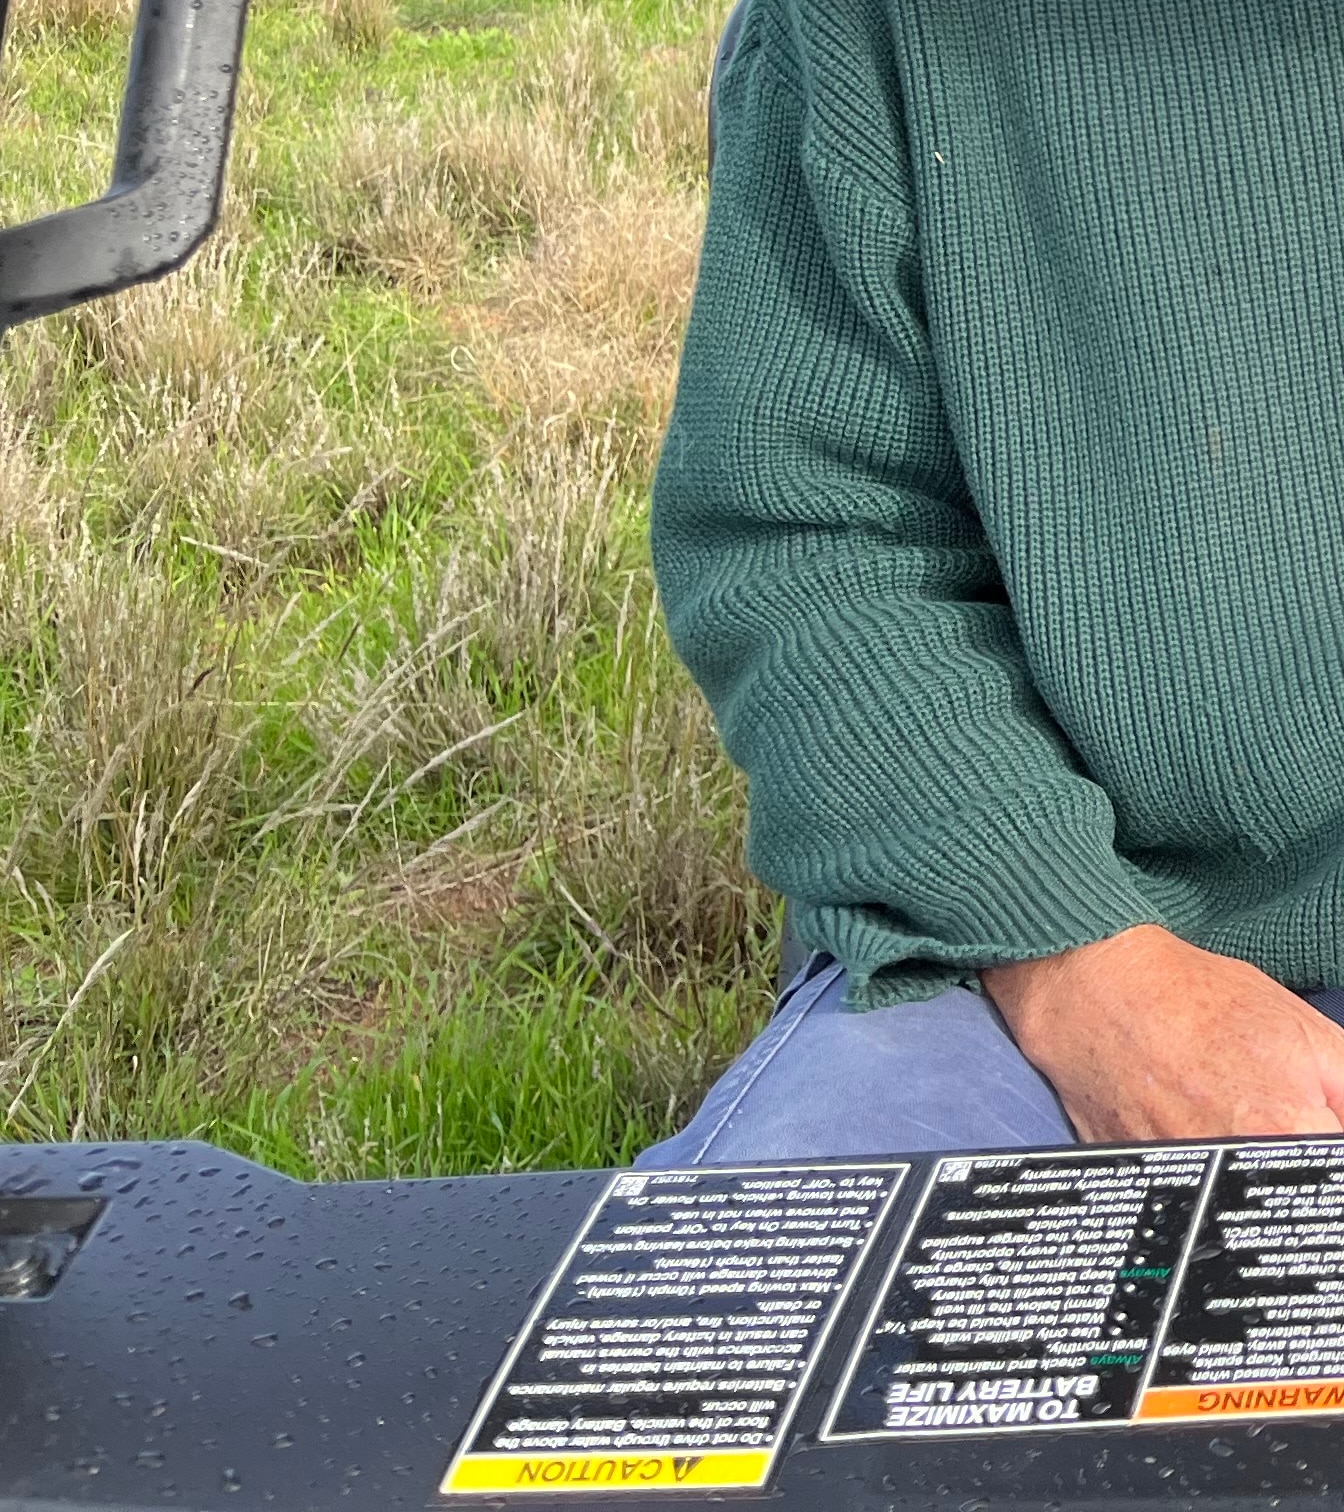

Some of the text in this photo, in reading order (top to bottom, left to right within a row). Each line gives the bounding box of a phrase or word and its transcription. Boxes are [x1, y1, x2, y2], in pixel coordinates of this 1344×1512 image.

[714, 1254, 764, 1268] 10mph
[766, 1255, 803, 1267] than
[800, 1254, 845, 1266] faster
[1238, 1265, 1286, 1279] frozen,
[1286, 1262, 1337, 1276] charge
[911, 1266, 1171, 1291] Always keep batteries fully charged.
[930, 1283, 1116, 1302] Do not overfill the battery
[756, 1300, 822, 1313] or death.
[933, 1304, 966, 1317] well
[966, 1303, 986, 1316] fill
[986, 1302, 1013, 1314] the
[1015, 1299, 1062, 1313] below
[545, 1314, 816, 1332] malfunction, fire, and/or severe injury
[928, 1326, 1101, 1346] Use only distilled water
[1246, 1325, 1312, 1340] batteries.
[539, 1343, 803, 1362] accordance with the owners manual
[1046, 1338, 1148, 1356] level monthly.
[1161, 1342, 1199, 1357] eyes
[1197, 1342, 1244, 1357] Shield
[1246, 1339, 1288, 1355] away.
[580, 1358, 796, 1375] Failure to maintain batteries in
[892, 1353, 1144, 1375] Always check and maintain water
[1191, 1353, 1244, 1370] sparks,
[1244, 1352, 1284, 1367] Keep
[1190, 1367, 1234, 1383] when
[1231, 1366, 1295, 1382] released
[1296, 1365, 1322, 1377] are
[507, 1379, 786, 1396] Batteries require regular maintenance.
[884, 1375, 1099, 1404] BATTERY LIFE
[701, 1399, 776, 1413] will occur.
[884, 1398, 1080, 1427] TO MAXIMIZE
[494, 1432, 765, 1450] Do not drive through water above the
[515, 1459, 663, 1484] CAUTION
